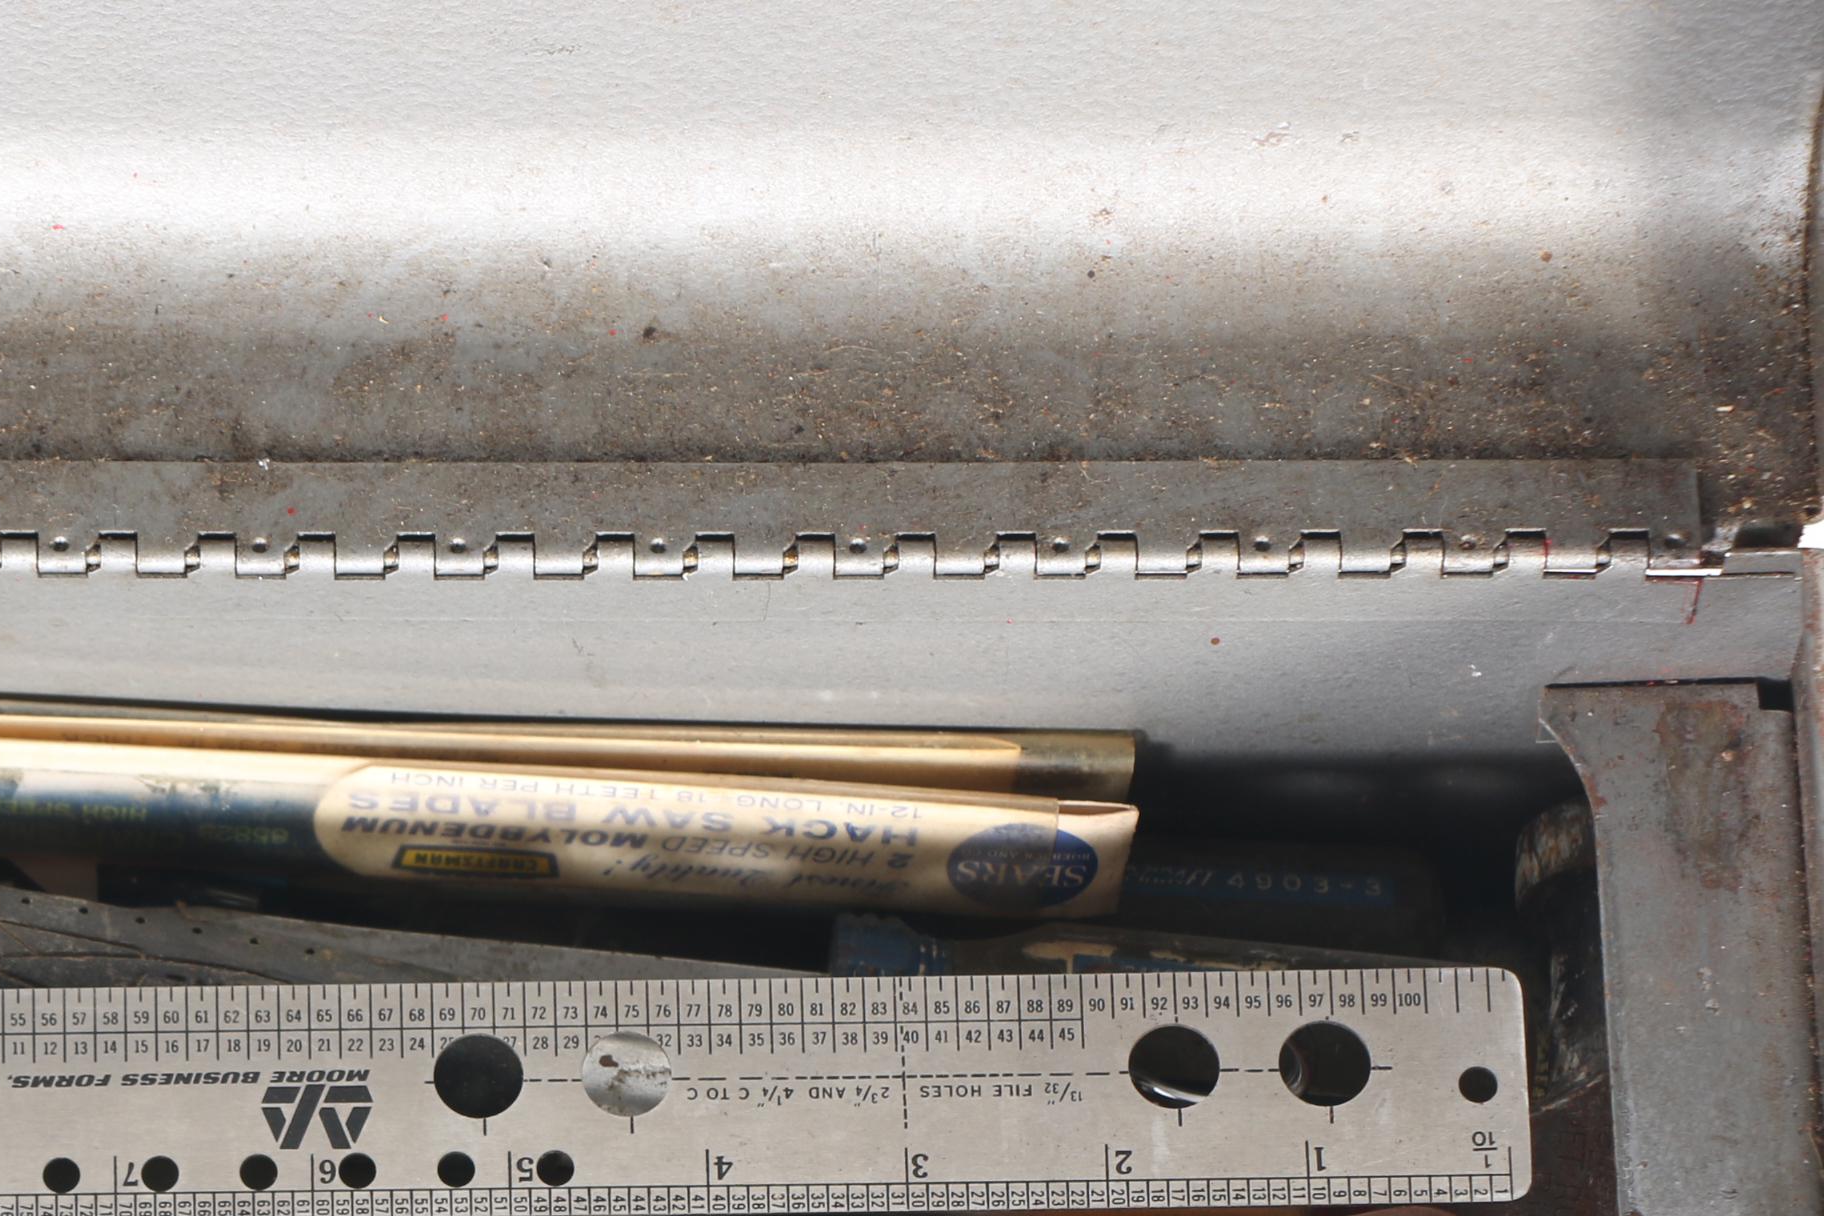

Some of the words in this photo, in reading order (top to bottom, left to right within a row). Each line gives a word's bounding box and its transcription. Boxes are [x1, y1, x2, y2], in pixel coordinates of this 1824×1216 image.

[392, 773, 463, 788] INCH
[476, 779, 537, 793] PER
[556, 783, 656, 799] TEETH
[677, 790, 705, 802] 18
[347, 793, 575, 821] BLADES
[736, 795, 821, 813] LONG
[833, 802, 918, 819] 12-IN.
[600, 806, 731, 832] SAW
[342, 816, 648, 849] MOLYBDENUM
[763, 819, 919, 847] HACK
[658, 833, 770, 860] SPEED
[415, 853, 537, 872] CRAFTSMAN
[788, 846, 875, 867] HIGH
[886, 852, 913, 868] 2
[956, 860, 1087, 888] SEARS
[41, 1012, 57, 1027] 56
[163, 1010, 180, 1025] 60
[285, 1009, 302, 1023] 64
[409, 1007, 425, 1022] 68
[531, 1005, 547, 1021] 72
[655, 1004, 672, 1018] 76
[777, 1002, 795, 1017] 80
[902, 1001, 919, 1015] 84
[1027, 999, 1044, 1013] 88
[1151, 996, 1168, 1011] 92
[1275, 993, 1293, 1009] 96
[1397, 992, 1421, 1007] 100
[74, 1041, 88, 1055] 13
[165, 1039, 179, 1053] 16
[257, 1038, 271, 1053] 19
[347, 1037, 364, 1052] 22
[532, 1035, 549, 1051] 28
[687, 1033, 703, 1048] 33
[779, 1031, 795, 1047] 36
[872, 1031, 889, 1045] 39
[965, 1029, 982, 1043] 42
[1058, 1027, 1075, 1041] 45
[6, 1074, 112, 1088] FORMS,
[121, 1071, 260, 1085] BUSINESS
[271, 1069, 371, 1083] MOORE
[687, 1088, 697, 1101] C
[707, 1087, 729, 1101] TO
[739, 1087, 750, 1100] C
[809, 1087, 846, 1100] AND
[919, 1086, 981, 1100] HOLES
[994, 1085, 1032, 1099] FILE
[122, 1161, 139, 1188] 7
[318, 1158, 336, 1184] 6
[516, 1155, 536, 1182] 5
[712, 1153, 733, 1177] 4
[909, 1152, 929, 1179] 3
[1113, 1149, 1134, 1175] 2
[1312, 1146, 1326, 1170] 1
